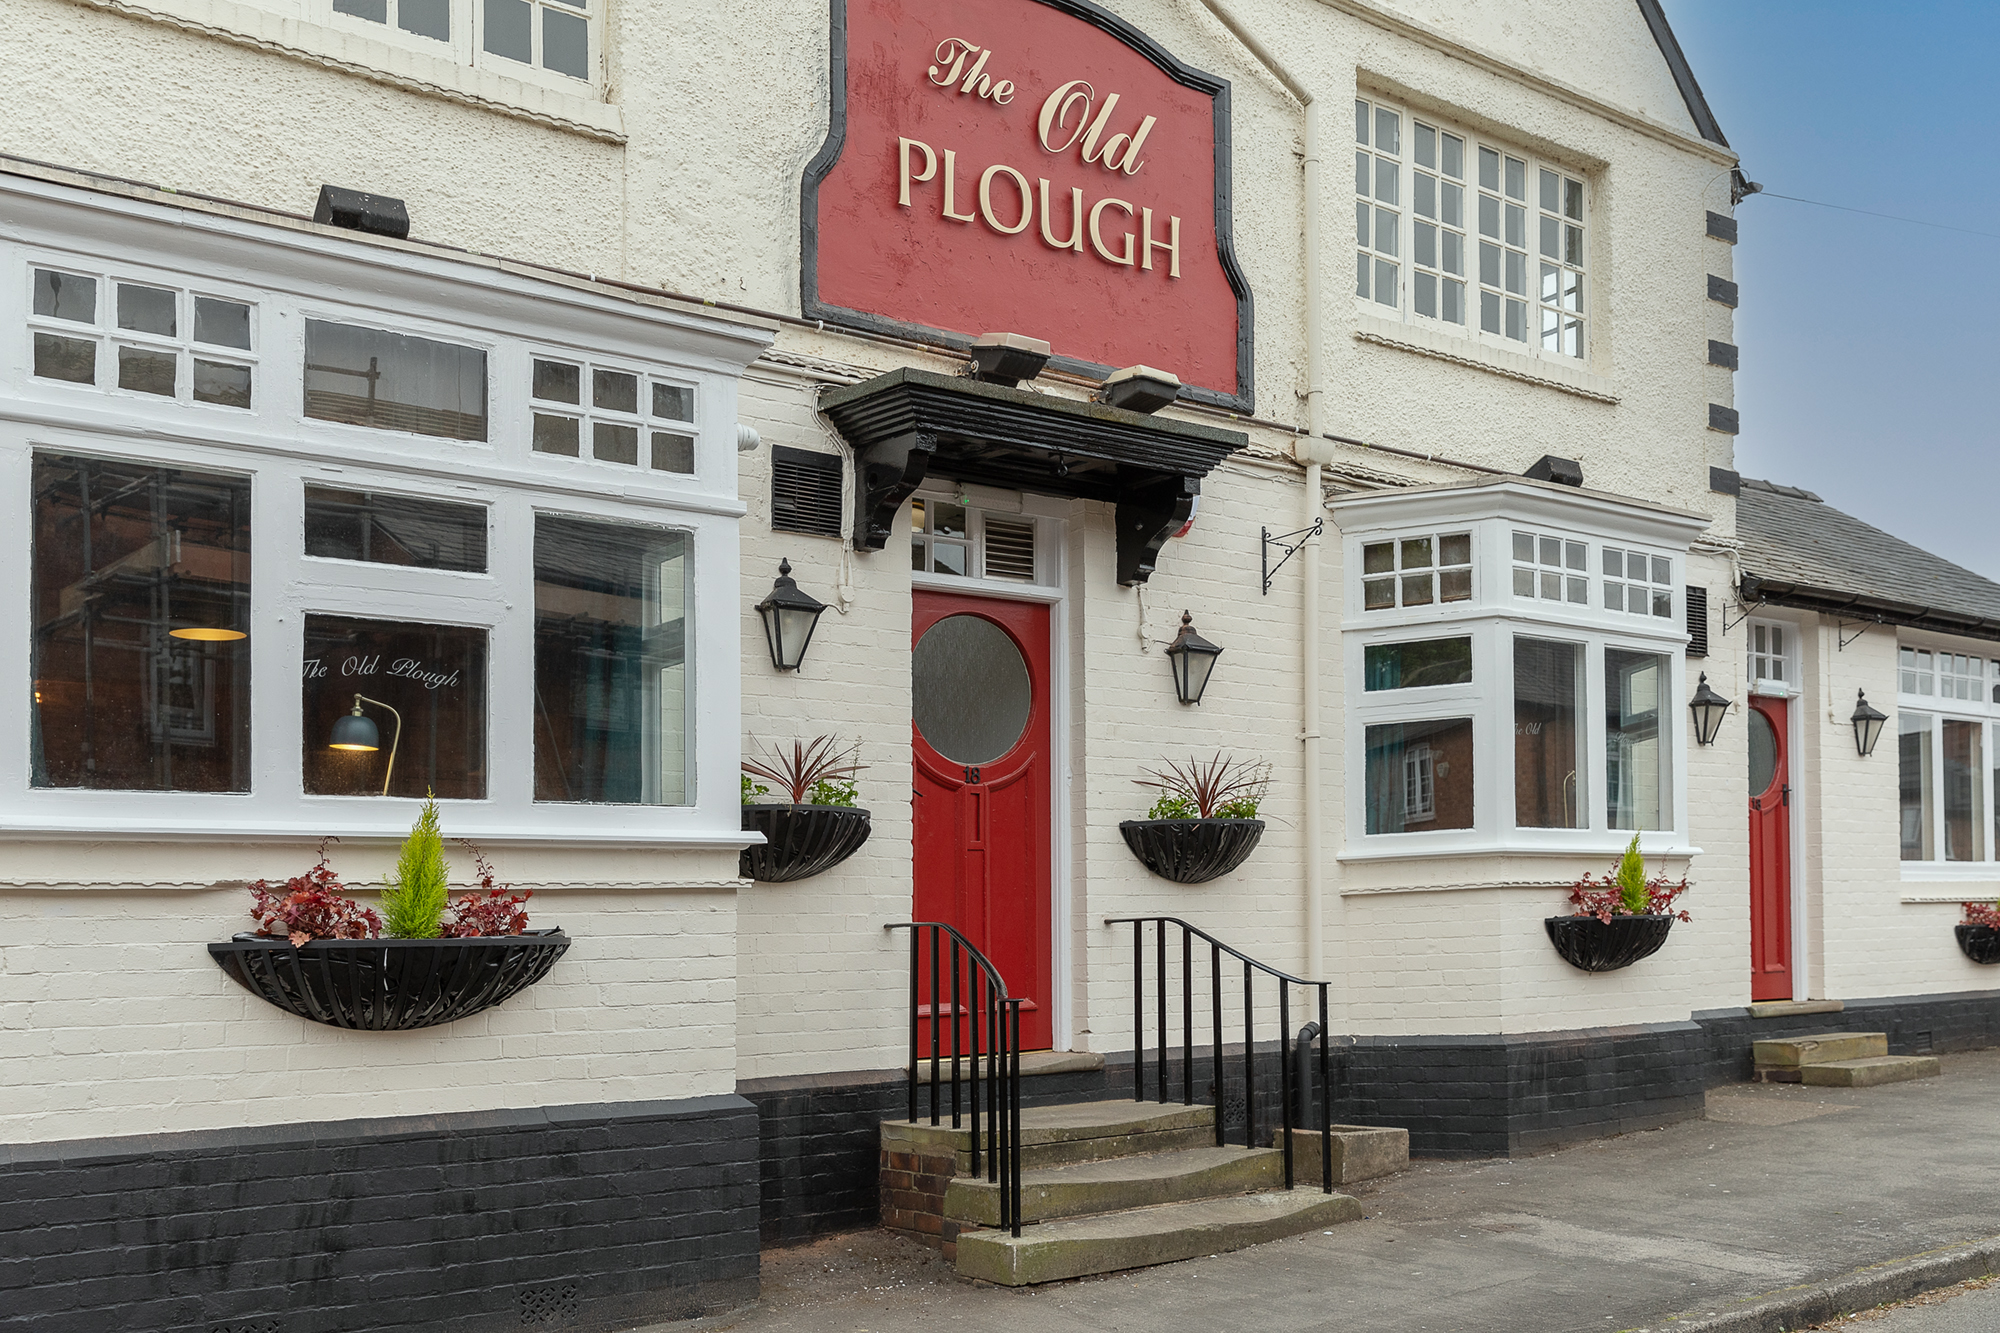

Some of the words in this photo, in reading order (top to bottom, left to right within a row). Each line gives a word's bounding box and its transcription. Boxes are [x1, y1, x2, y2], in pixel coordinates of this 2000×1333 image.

[928, 37, 1015, 105] The
[1038, 80, 1157, 175] Old
[898, 136, 1181, 279] PLOUGH
[303, 659, 328, 678] The
[341, 655, 380, 677] Old
[386, 658, 460, 690] Plough
[1515, 723, 1523, 735] he
[1525, 722, 1542, 735] Old
[963, 766, 981, 784] 18
